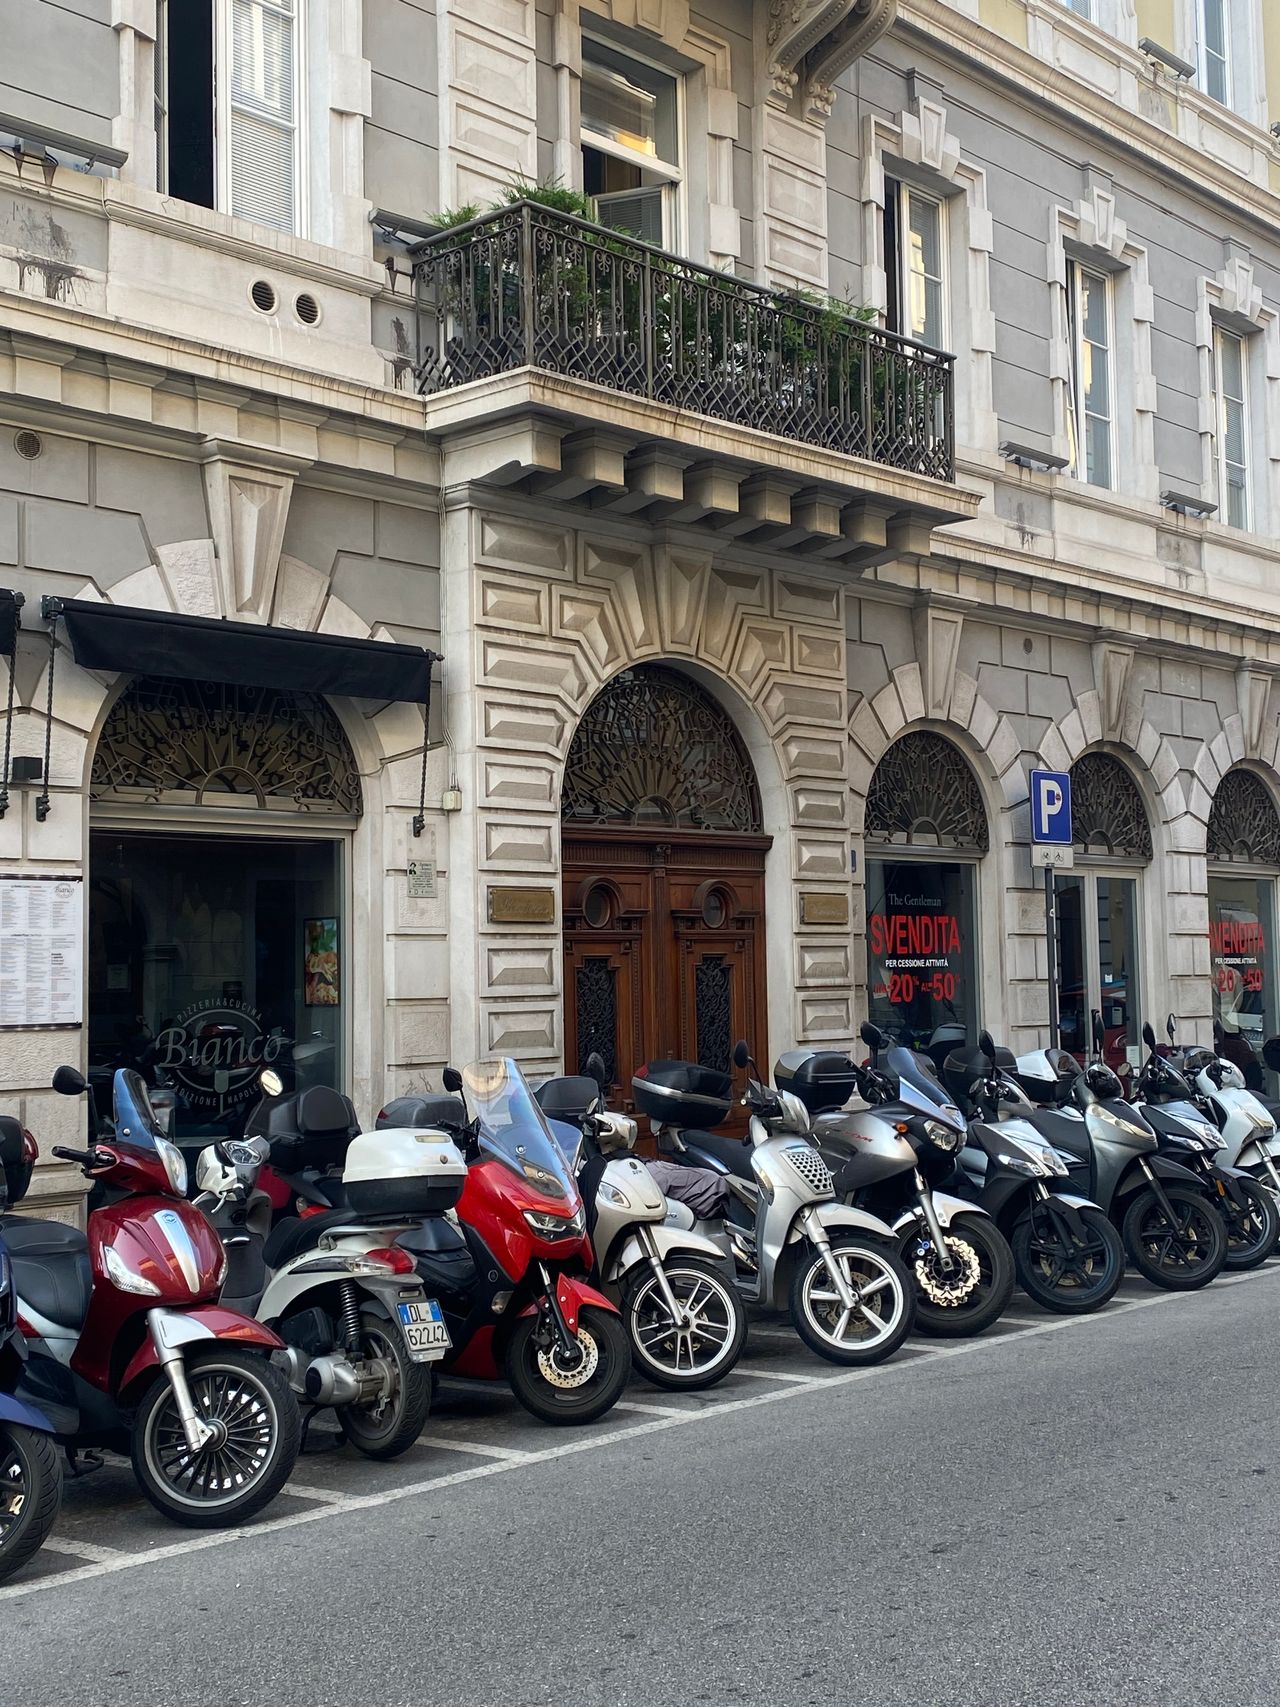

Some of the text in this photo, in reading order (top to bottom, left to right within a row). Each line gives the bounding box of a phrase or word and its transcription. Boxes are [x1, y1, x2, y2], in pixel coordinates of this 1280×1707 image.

[1040, 779, 1063, 833] P
[888, 893, 942, 907] The Gentleman
[871, 914, 961, 954] SVENDITA
[885, 960, 897, 968] PER
[897, 960, 925, 968] CESSIONE
[155, 1027, 297, 1068] Bianco
[227, 1083, 260, 1104] NAPOLE
[409, 1304, 426, 1322] DL
[407, 1325, 447, 1346] 62242
